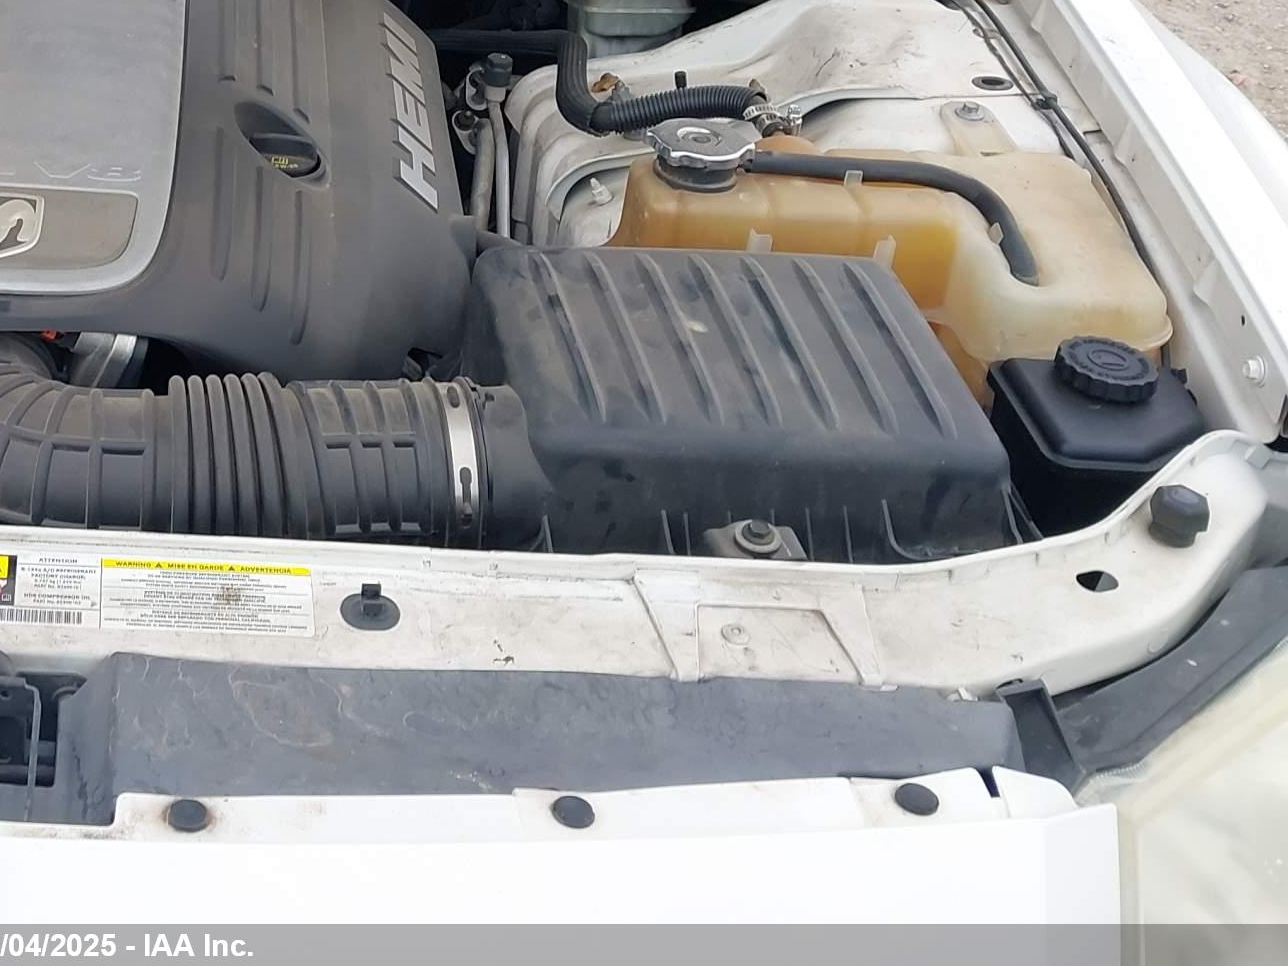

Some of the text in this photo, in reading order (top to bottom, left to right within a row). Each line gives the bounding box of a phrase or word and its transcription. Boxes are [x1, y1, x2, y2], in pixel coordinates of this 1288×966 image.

[383, 12, 439, 210] HEMI
[33, 160, 142, 182] V8
[240, 566, 292, 574] ADVERTENCIA
